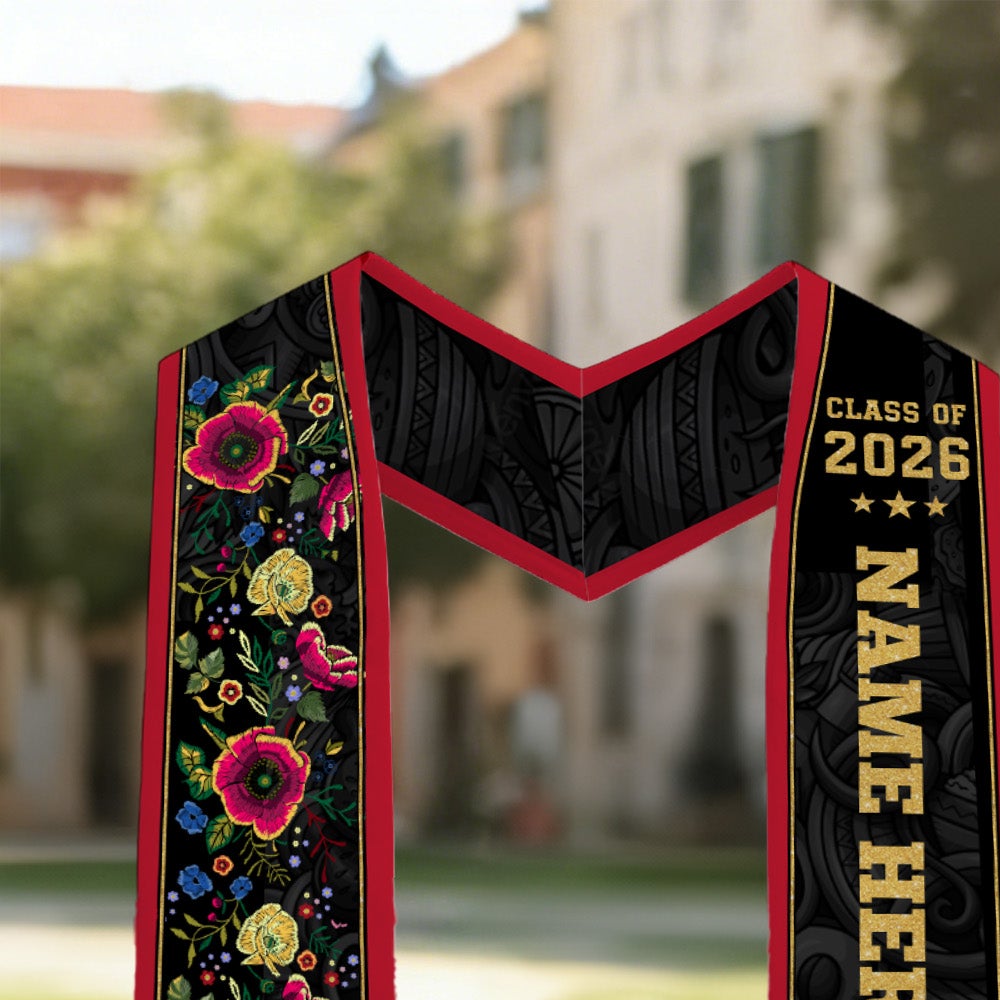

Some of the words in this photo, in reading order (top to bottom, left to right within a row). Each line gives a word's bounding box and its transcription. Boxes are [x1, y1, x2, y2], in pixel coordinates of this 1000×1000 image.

[826, 396, 920, 424] CLASS
[932, 403, 967, 426] OF
[824, 430, 970, 480] 2026
[855, 545, 925, 815] NAME
